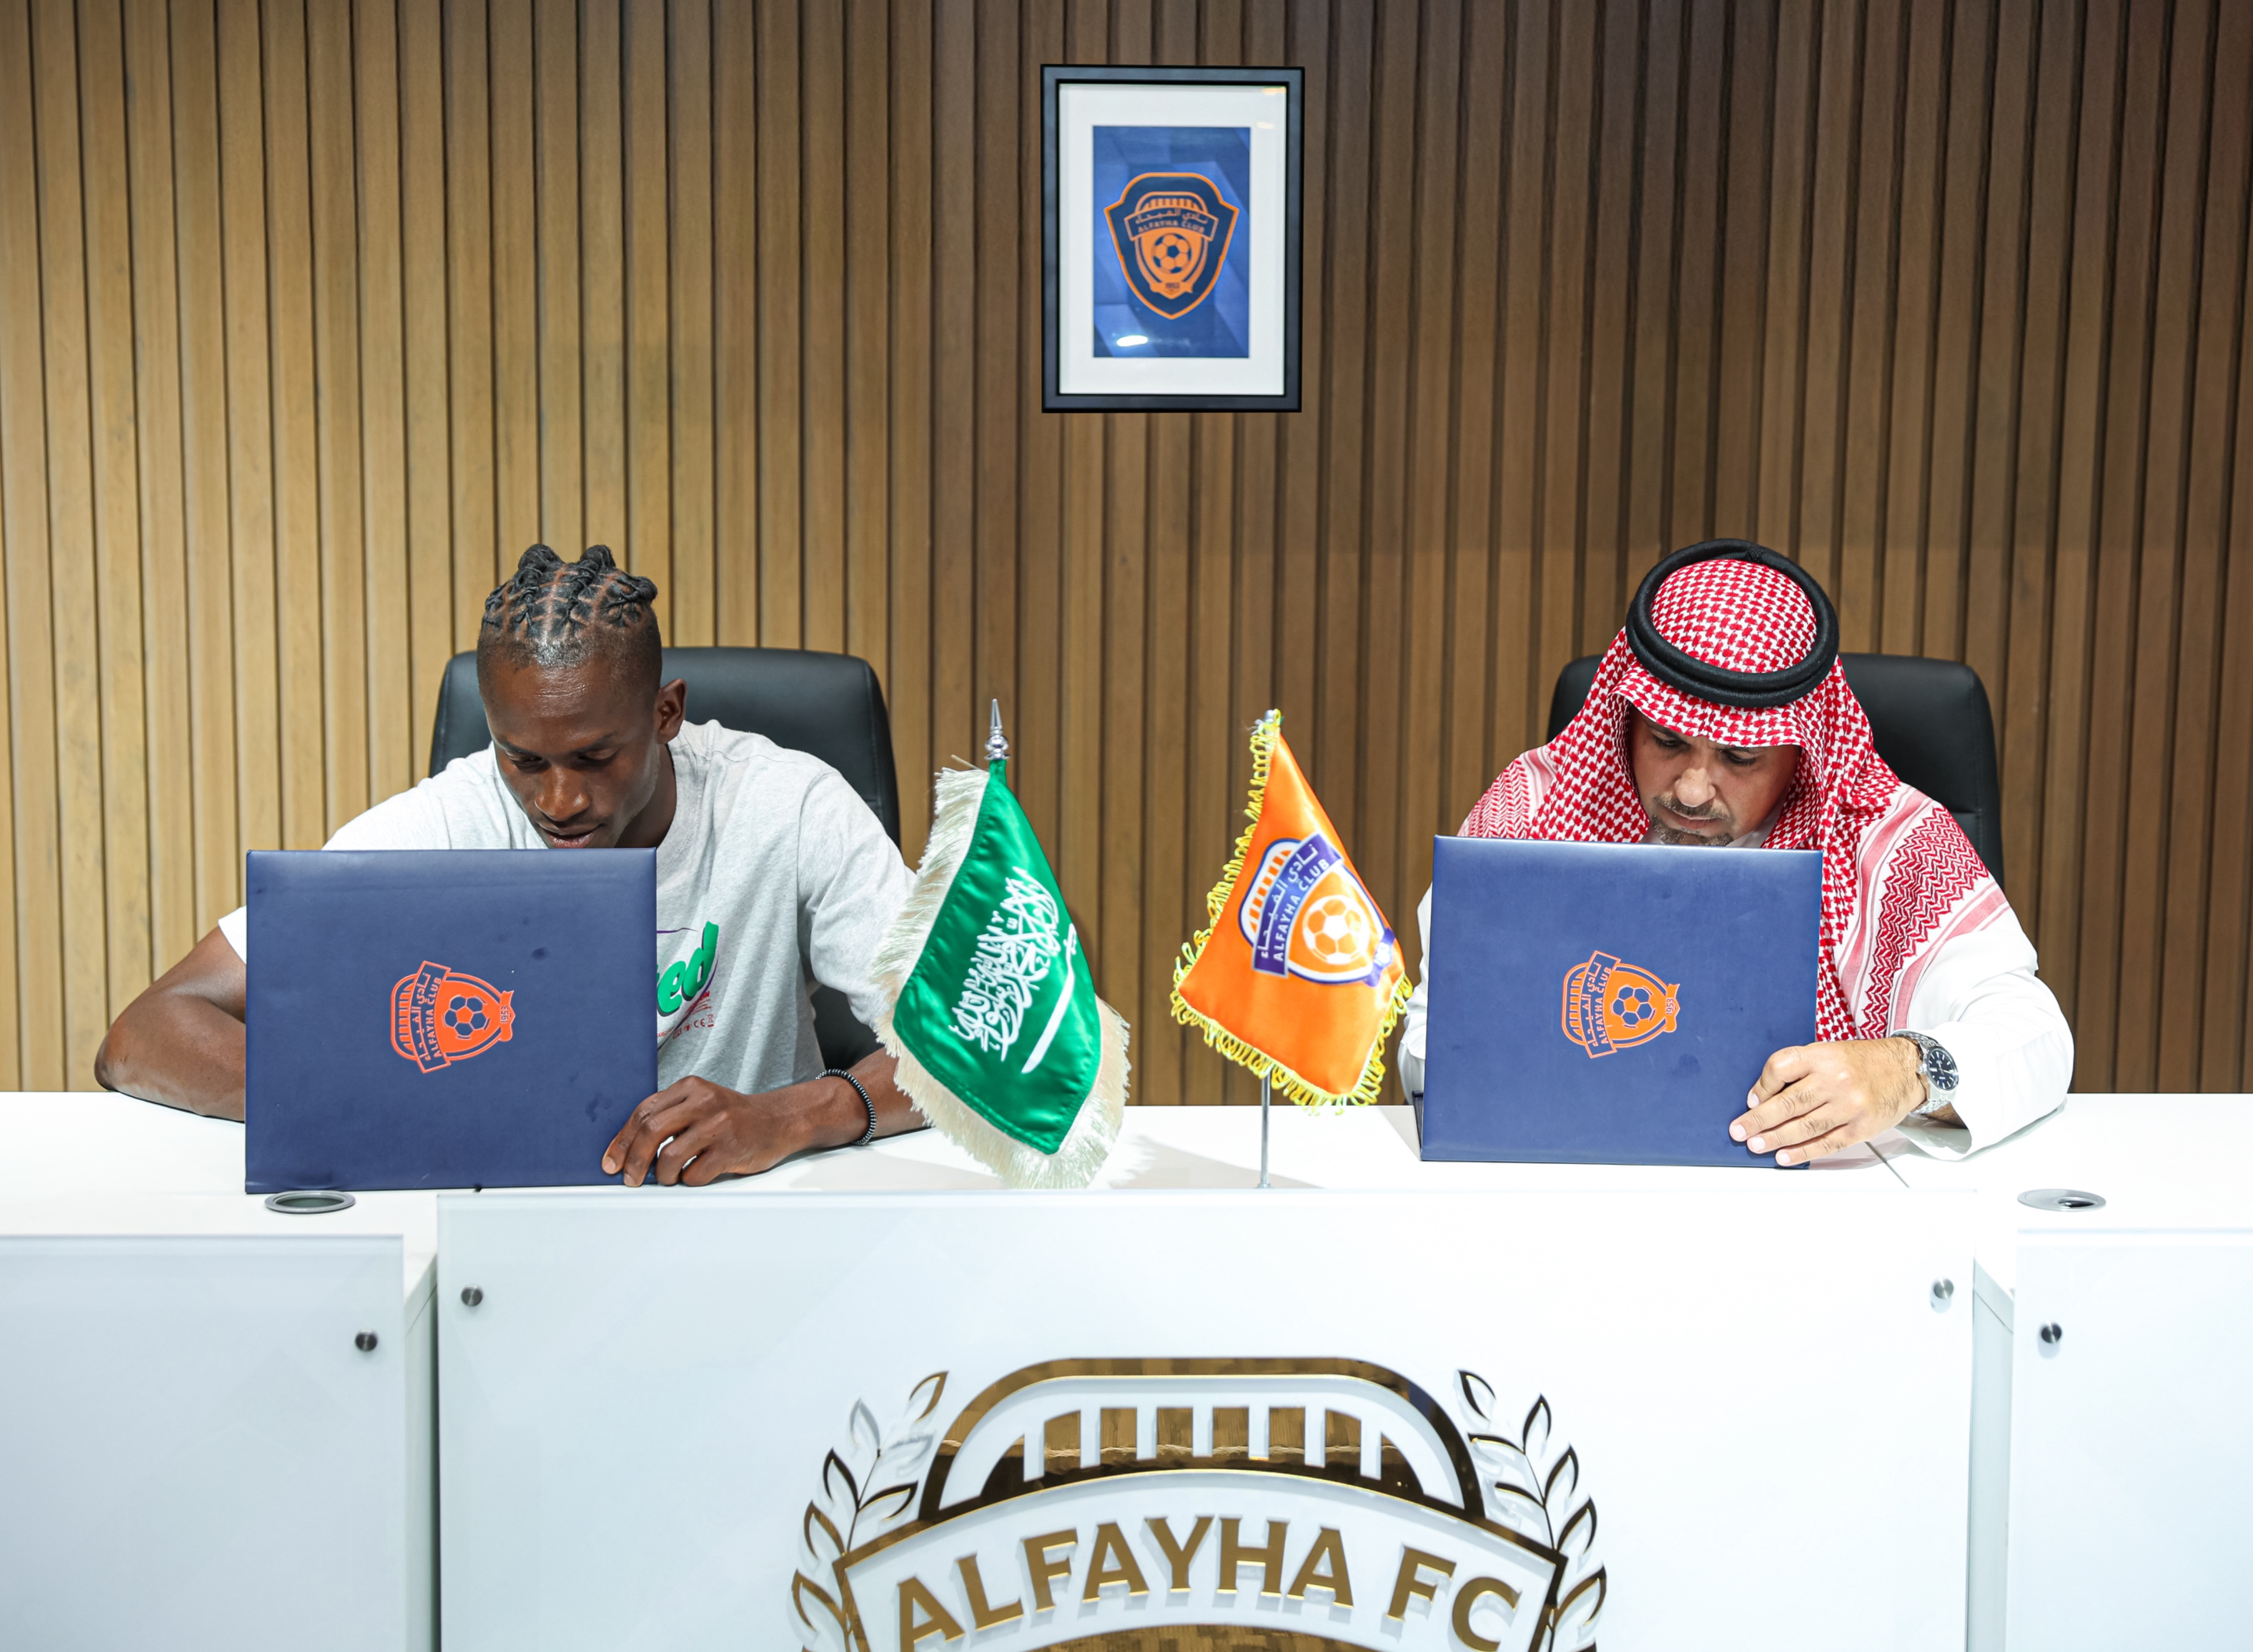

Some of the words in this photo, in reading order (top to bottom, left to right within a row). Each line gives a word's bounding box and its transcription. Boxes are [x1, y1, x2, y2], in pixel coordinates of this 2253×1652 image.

[1181, 220, 1205, 234] CLUB
[1273, 895, 1301, 962] ALFAYHA
[1298, 859, 1330, 892] CLUB
[427, 977, 442, 1004] CLUB
[1597, 967, 1612, 993] CLUB
[501, 1005, 509, 1023] 1953
[1666, 999, 1674, 1015] 1953
[425, 1009, 442, 1058] ALFAYHA
[1594, 998, 1609, 1044] ALFAYHA
[898, 1515, 1355, 1652] ALFAYHA
[1384, 1545, 1523, 1652] FC
